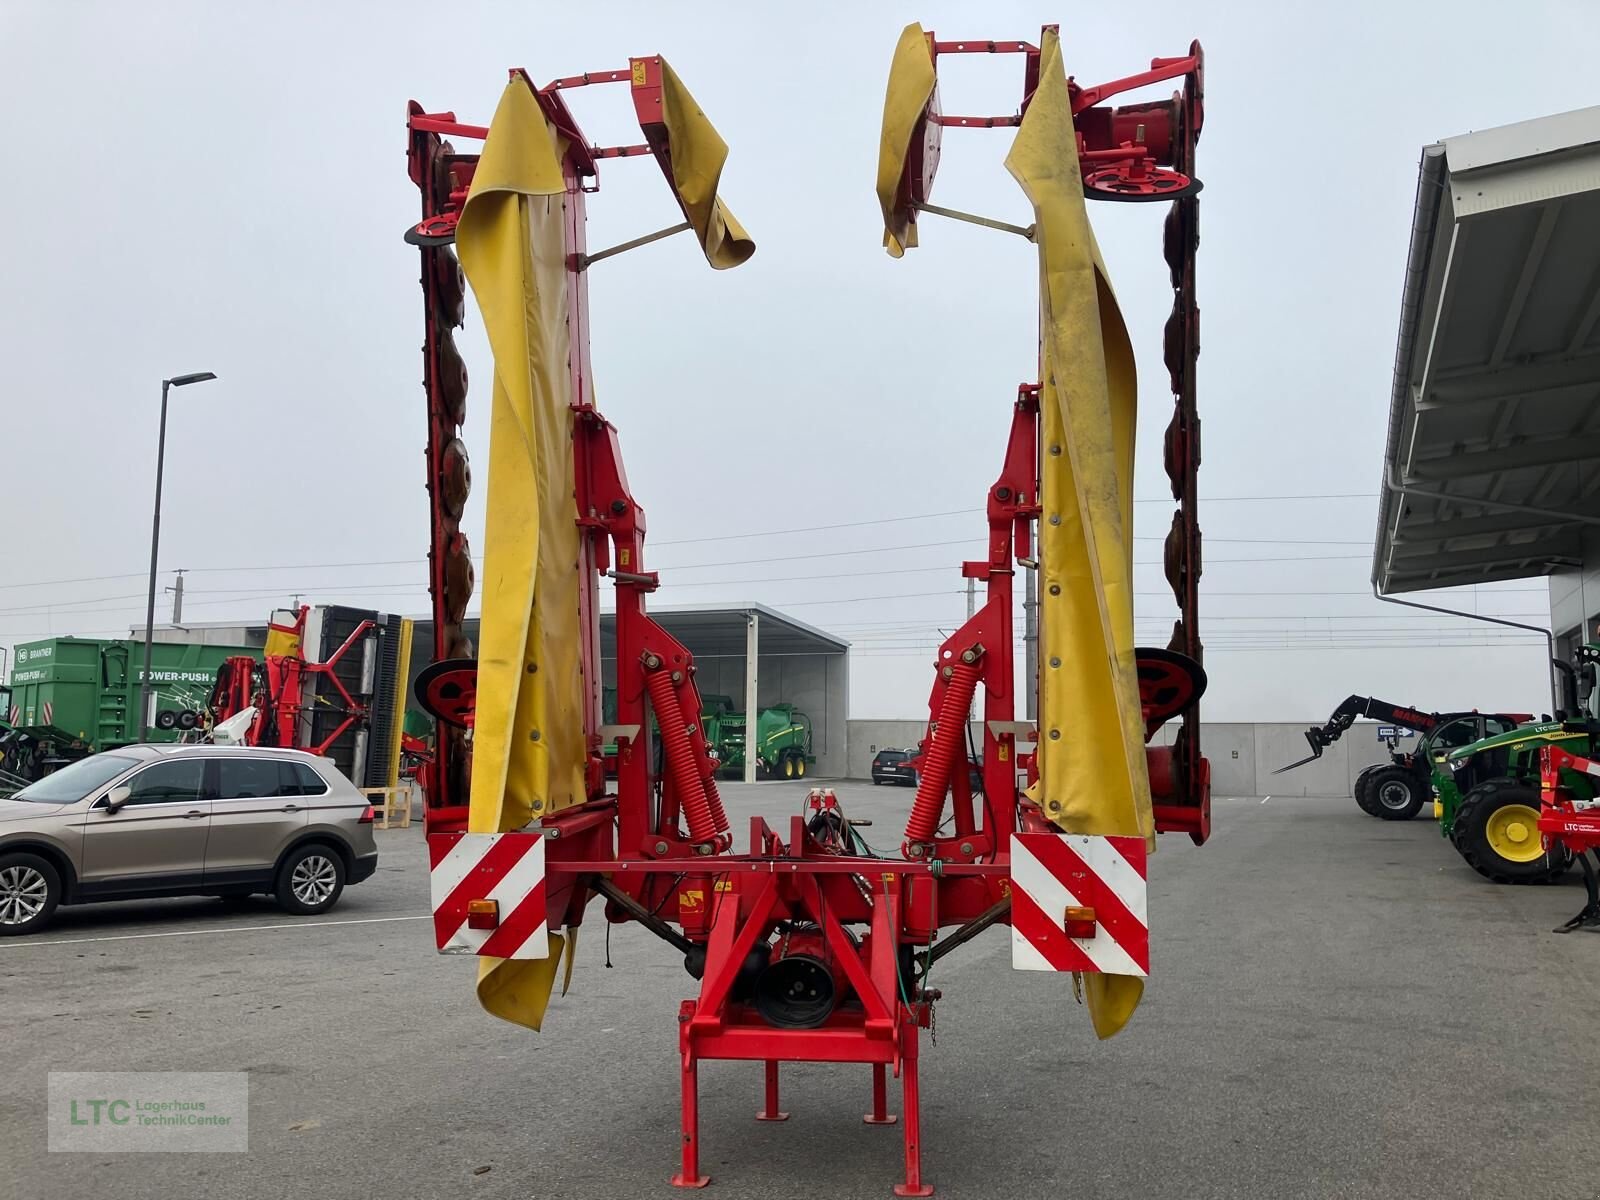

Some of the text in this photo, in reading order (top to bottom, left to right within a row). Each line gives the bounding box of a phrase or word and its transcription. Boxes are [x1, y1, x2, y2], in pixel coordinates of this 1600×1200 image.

[14, 670, 41, 682] POWER-PUSH
[1535, 725, 1549, 733] LTC
[1564, 823, 1578, 831] LTC
